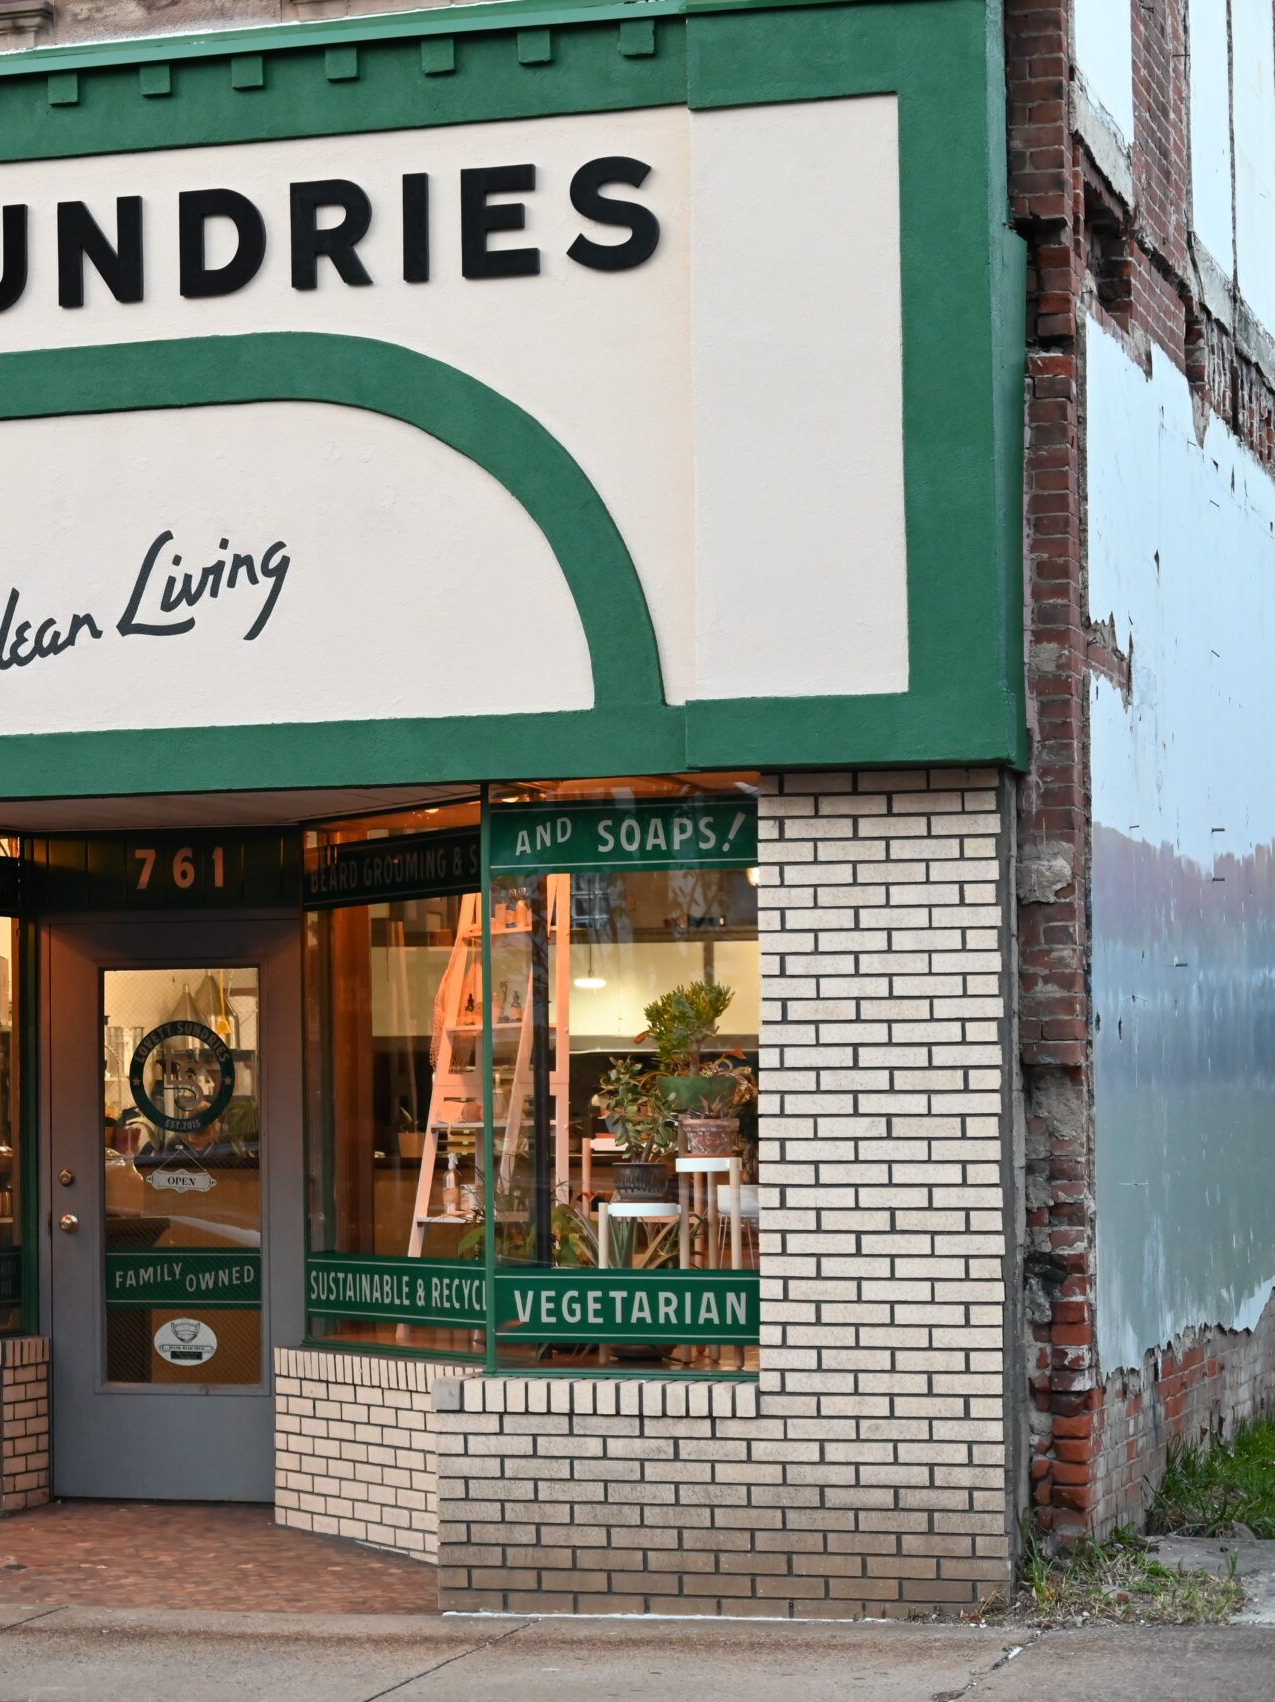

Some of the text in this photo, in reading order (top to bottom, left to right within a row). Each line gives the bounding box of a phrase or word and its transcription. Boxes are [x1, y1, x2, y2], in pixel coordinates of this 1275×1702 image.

[115, 530, 291, 641] Living
[514, 811, 746, 857] AND SOAPS!
[310, 859, 358, 893] BEARD
[363, 847, 446, 887] GROOMING
[134, 1021, 231, 1063] LOVETT SUNDRIES
[167, 1176, 196, 1187] OPEN
[115, 1262, 254, 1292] FAMILY OWNED
[310, 1270, 410, 1307] SUSTAINABLE
[416, 1279, 426, 1306] &
[513, 1289, 747, 1325] VEGETARIAN
